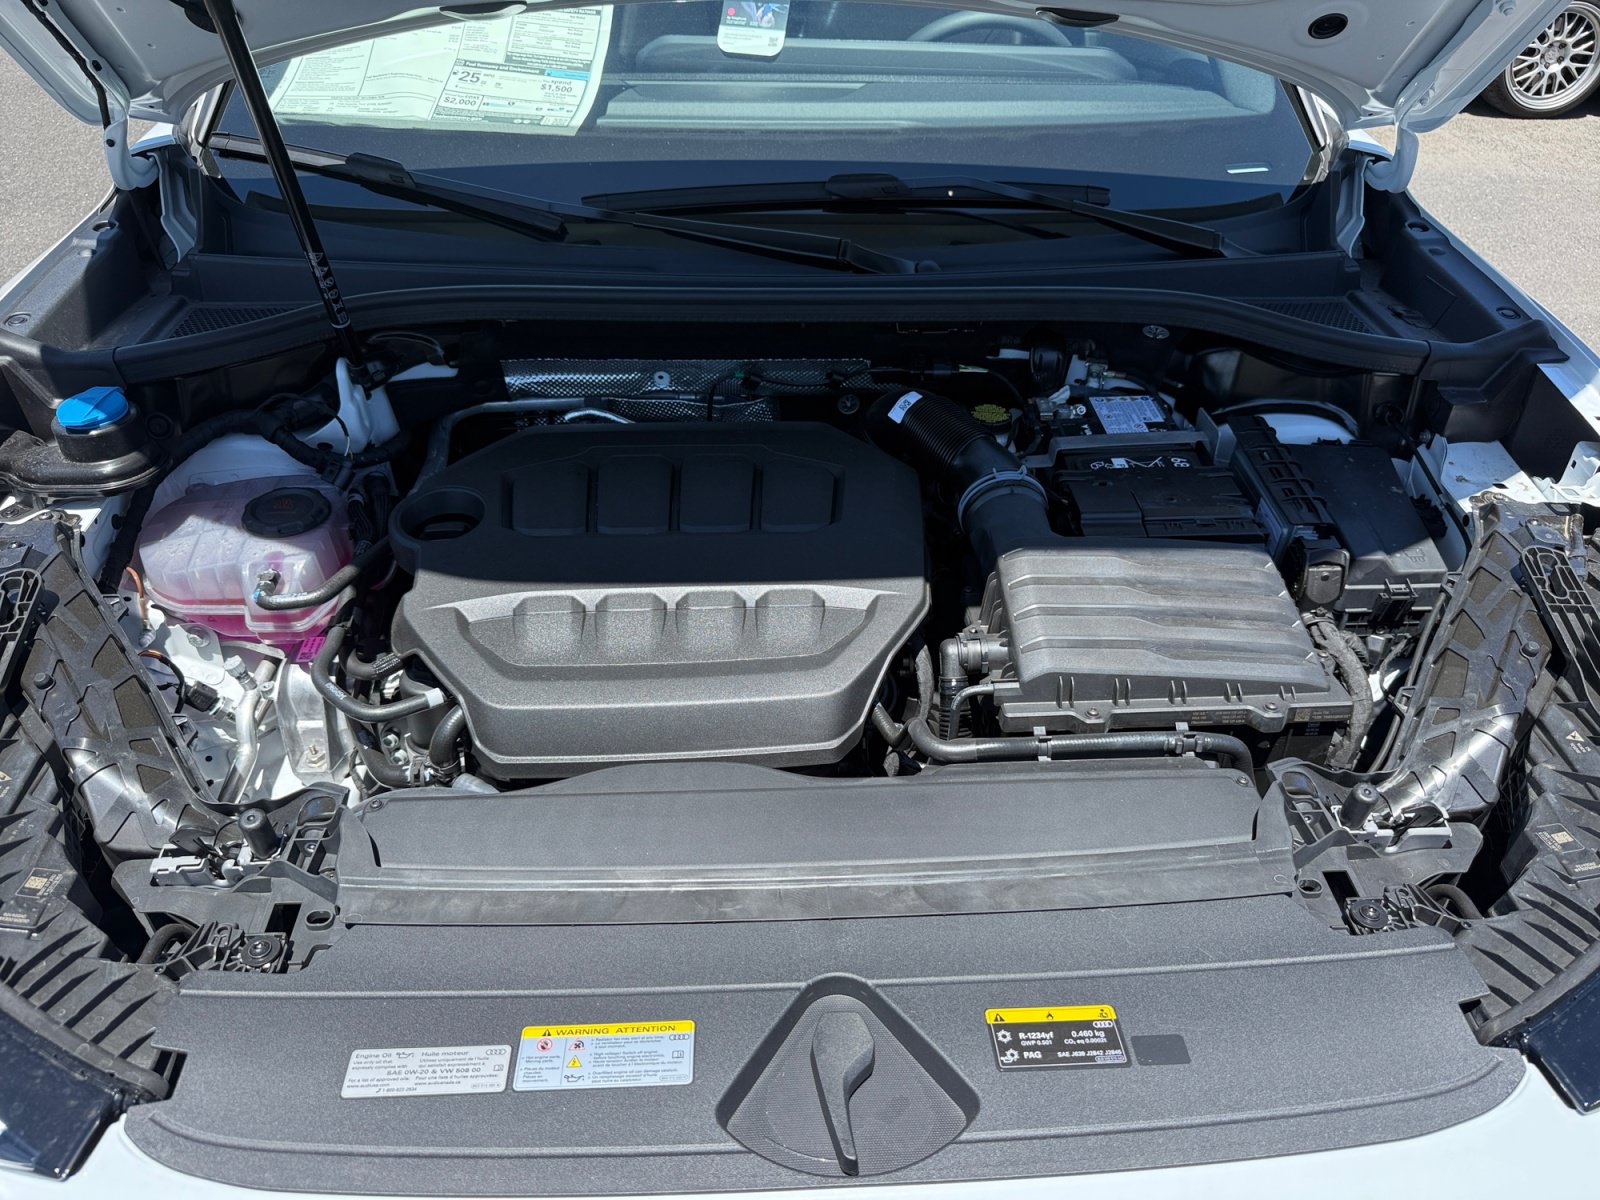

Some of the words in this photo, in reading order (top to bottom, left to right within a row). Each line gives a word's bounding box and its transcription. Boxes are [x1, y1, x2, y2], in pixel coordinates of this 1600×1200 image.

[458, 71, 481, 83] 25
[540, 83, 572, 92] $1,500
[444, 96, 476, 106] $2,000
[556, 1028, 609, 1036] WARNING
[615, 1025, 676, 1034] ATTENTION
[1019, 1032, 1054, 1040] R-1234yf
